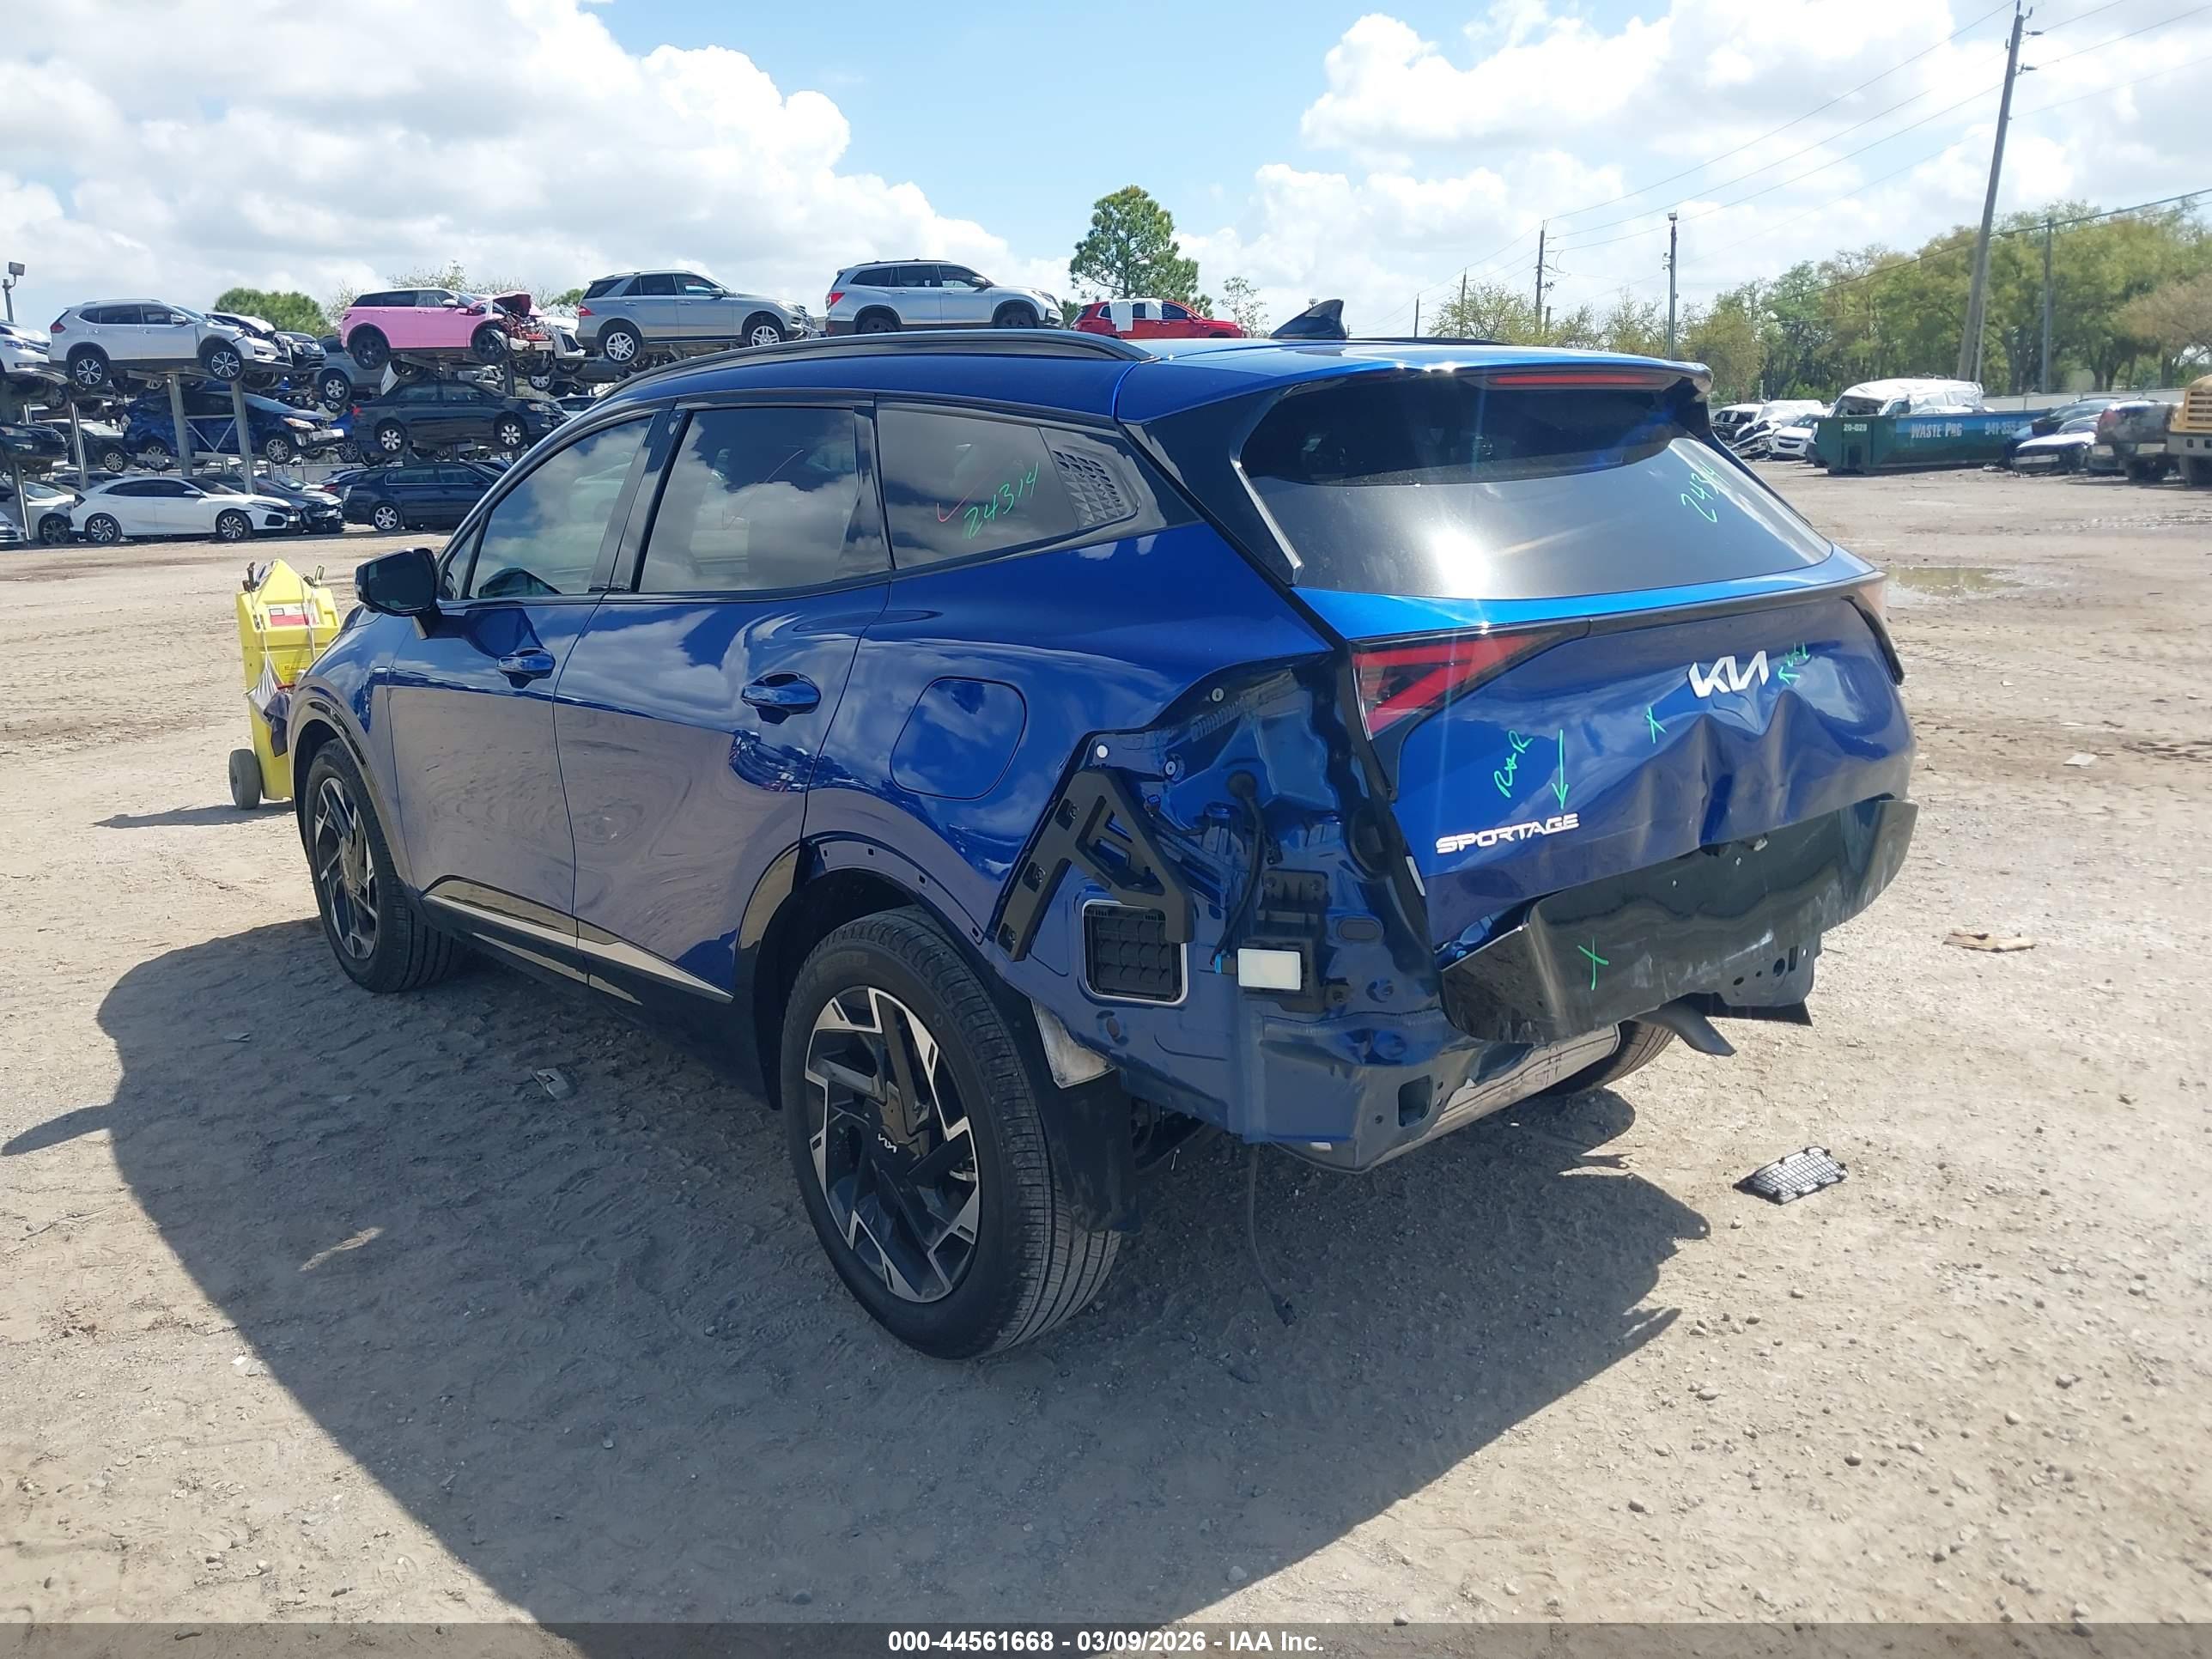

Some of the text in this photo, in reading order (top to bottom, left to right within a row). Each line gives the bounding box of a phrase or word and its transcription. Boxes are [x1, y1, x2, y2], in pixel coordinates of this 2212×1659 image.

[1911, 423, 1942, 439] WASTE
[963, 461, 1039, 541] 24314
[1687, 650, 1770, 698] KIA
[1436, 812, 1580, 854] SPORTAGE
